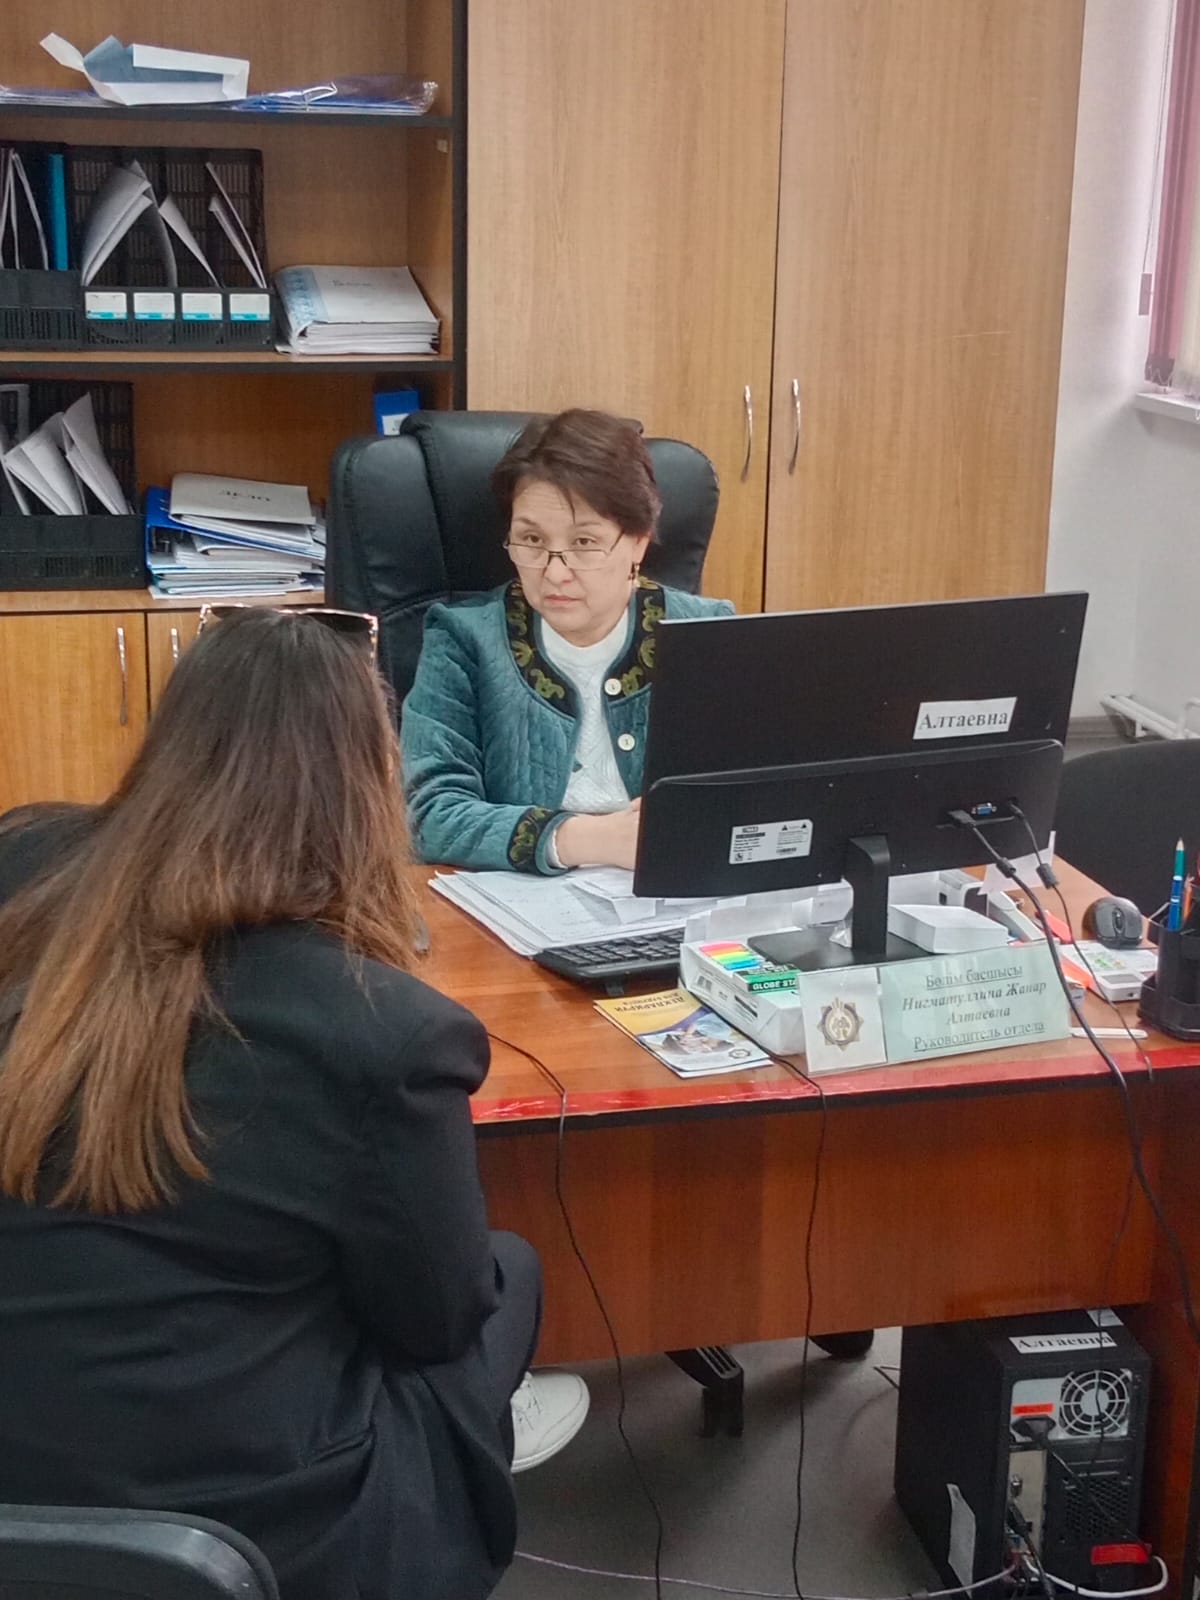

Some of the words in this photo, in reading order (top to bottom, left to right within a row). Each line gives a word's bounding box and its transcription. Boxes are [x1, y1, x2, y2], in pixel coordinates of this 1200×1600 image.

[917, 711, 1009, 730] Алтаевна
[966, 965, 1023, 982] басшысы
[752, 980, 780, 990] GLOBE
[901, 988, 1003, 1012] Нигматуллина
[1005, 981, 1047, 998] Жанар
[945, 1006, 1012, 1025] Алтаевна
[912, 1028, 1001, 1052] Руководитель
[1003, 1021, 1046, 1036] отдела
